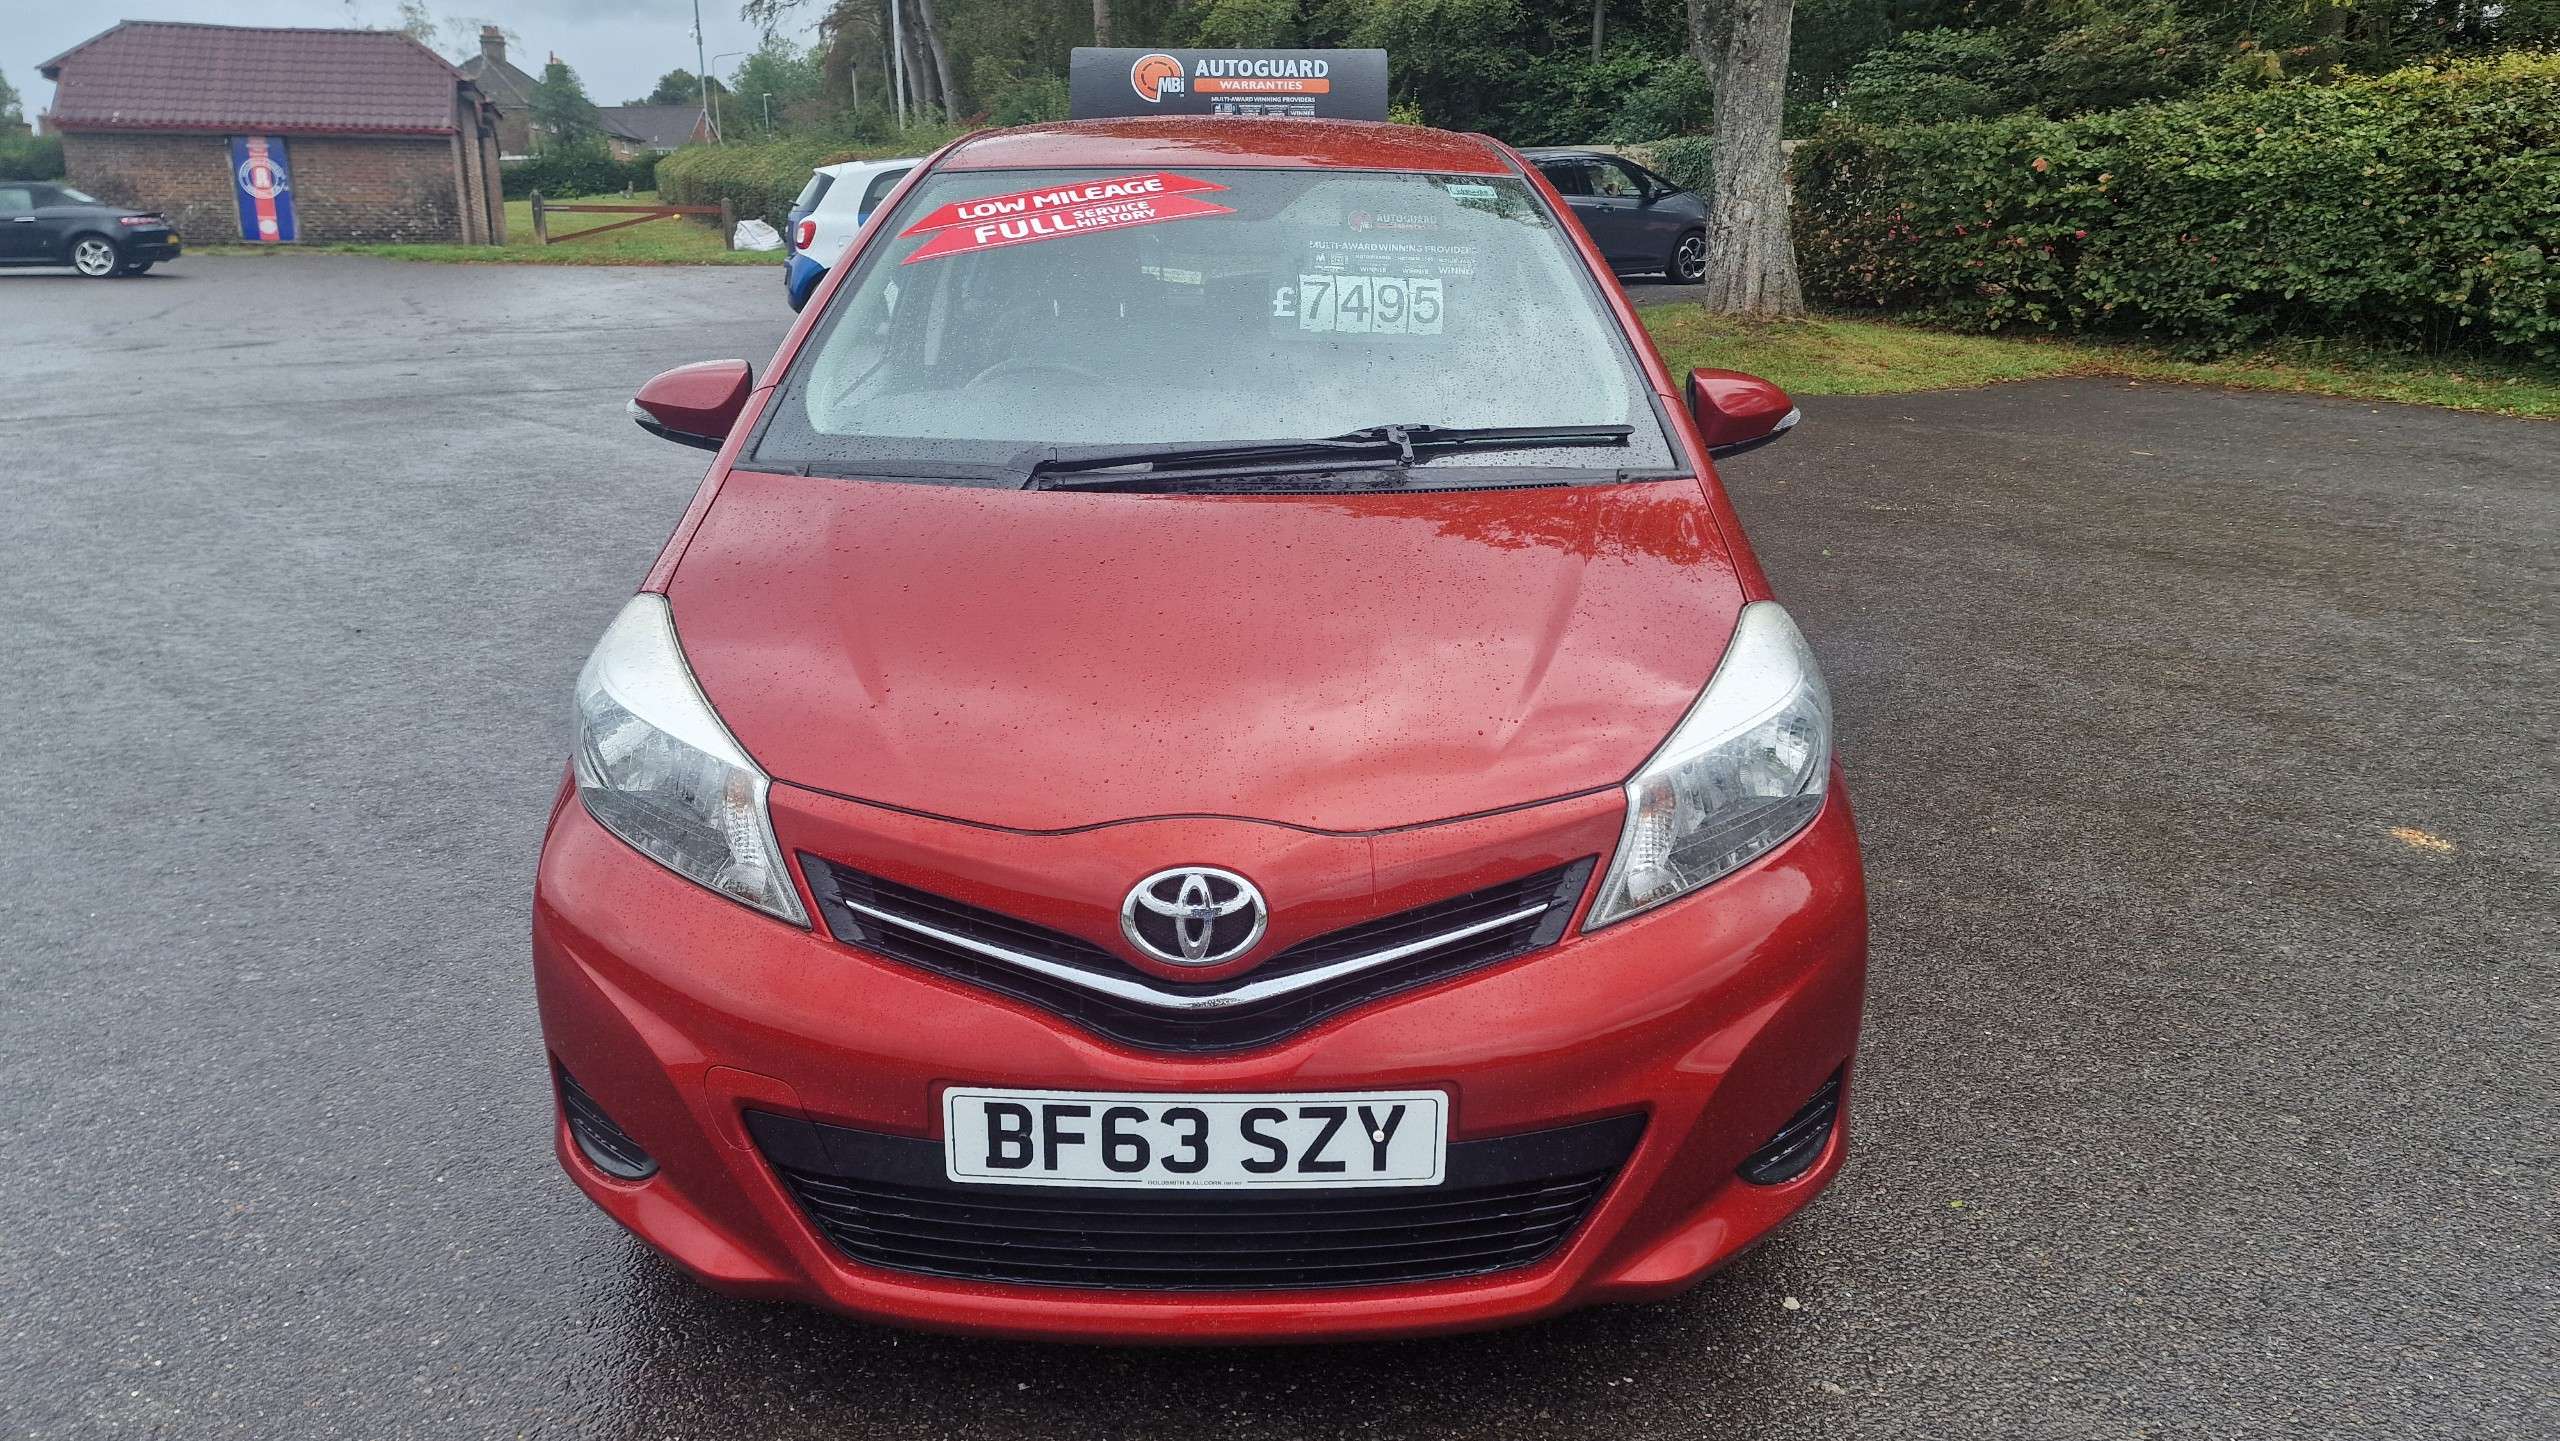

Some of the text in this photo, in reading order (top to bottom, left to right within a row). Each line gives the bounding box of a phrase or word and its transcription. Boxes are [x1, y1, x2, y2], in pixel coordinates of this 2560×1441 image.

[1195, 59, 1329, 78] AUTOGUARD
[1219, 80, 1303, 91] WARRANTIES
[957, 178, 1165, 220] LOW MILEAGE
[1073, 201, 1149, 220] SERVICE
[1076, 208, 1157, 229] HISTORY
[974, 214, 1078, 244] FULL
[1309, 240, 1378, 251] MULTI-AWARD
[1379, 243, 1423, 253] WINNING
[983, 1102, 1406, 1174] BF63 SZY
